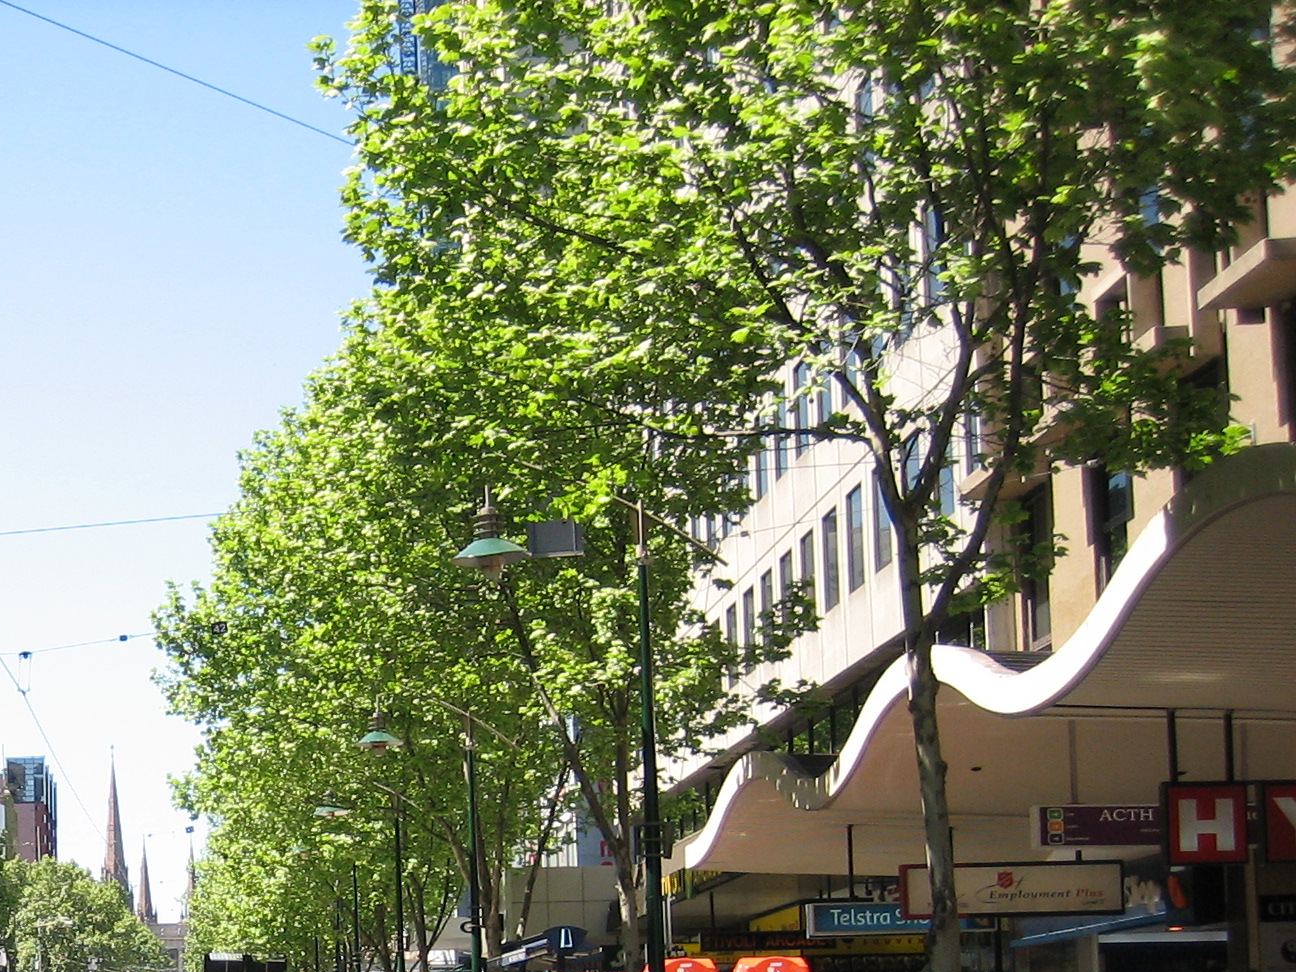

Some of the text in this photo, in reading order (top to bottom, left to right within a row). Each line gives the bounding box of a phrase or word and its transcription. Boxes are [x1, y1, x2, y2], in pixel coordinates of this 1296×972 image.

[1178, 797, 1236, 852] H
[989, 887, 1104, 901] Employment Plus
[829, 909, 891, 925] Telstra
